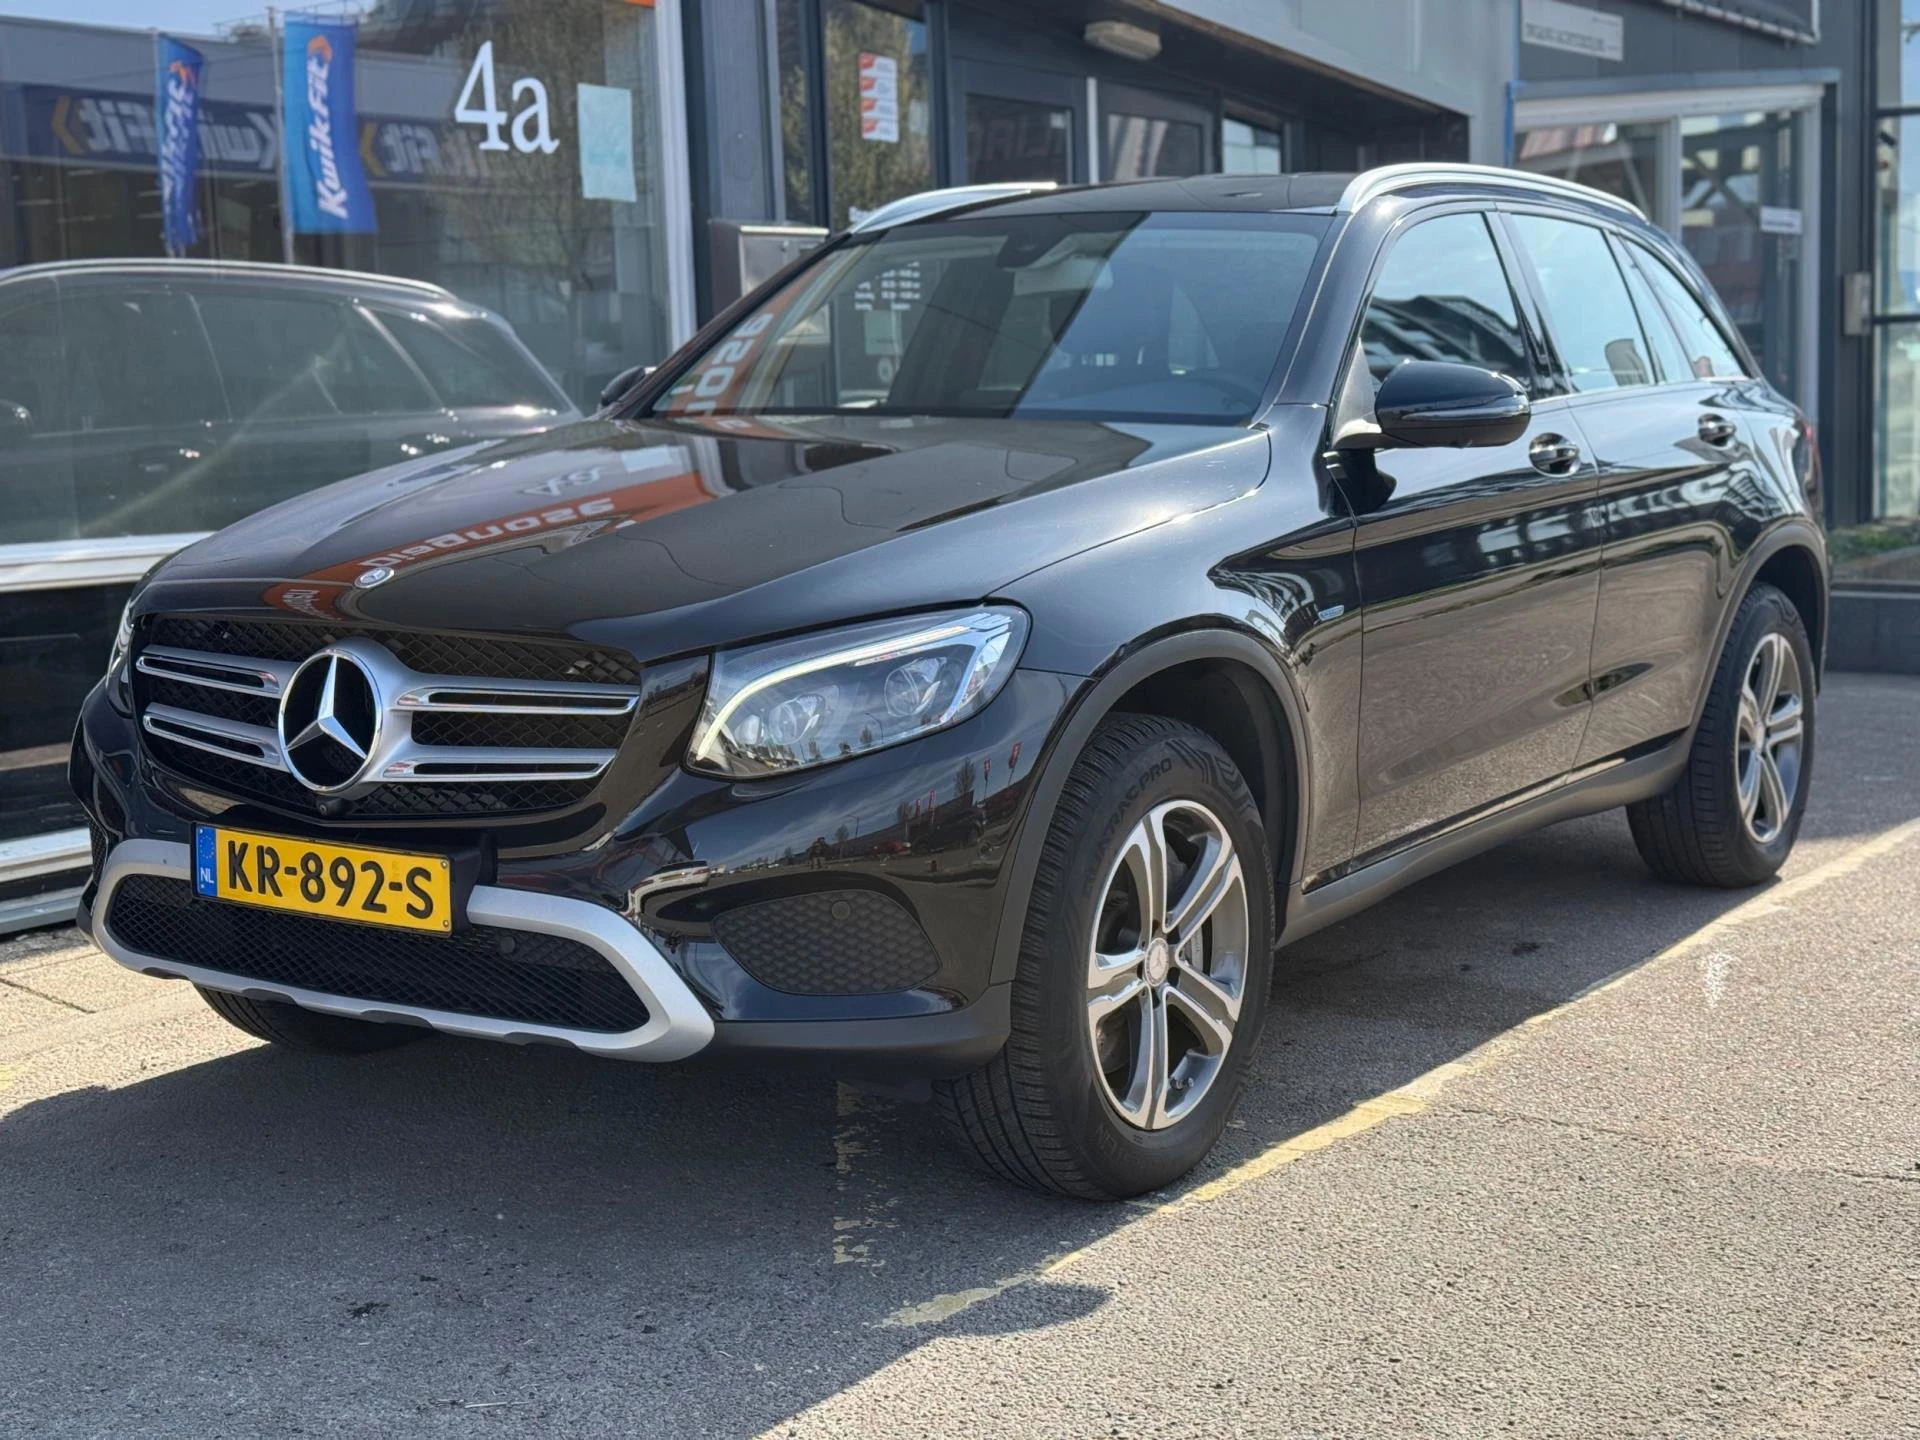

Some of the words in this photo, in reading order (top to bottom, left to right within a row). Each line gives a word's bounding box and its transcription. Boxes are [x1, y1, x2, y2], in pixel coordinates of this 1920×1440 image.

[454, 40, 560, 154] 4a
[306, 57, 348, 219] KwikFit
[1139, 757, 1173, 791] PRO
[200, 867, 215, 884] NL
[227, 840, 434, 920] KR-892-S
